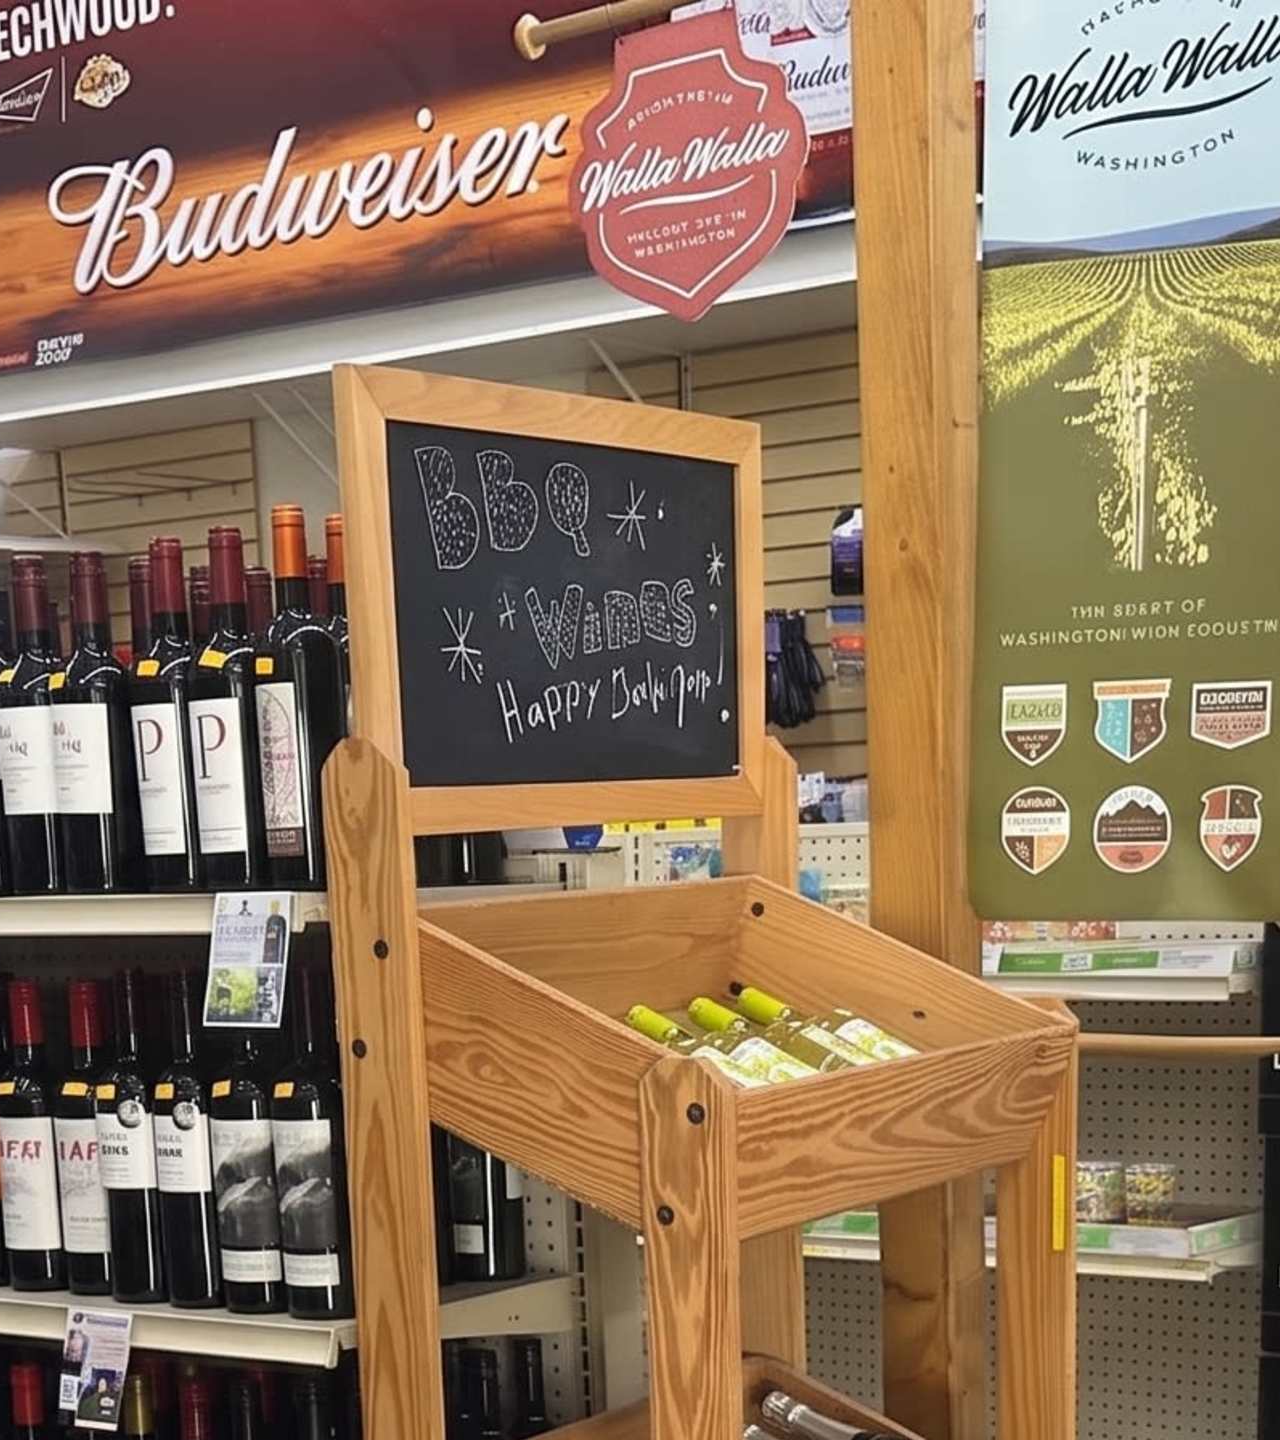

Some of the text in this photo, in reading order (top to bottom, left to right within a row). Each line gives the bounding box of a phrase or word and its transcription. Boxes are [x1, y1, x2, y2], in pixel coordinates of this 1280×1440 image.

[1008, 48, 1158, 138] Walla
[579, 121, 790, 213] Walla Walla
[1076, 128, 1235, 171] WASHINGTON
[48, 108, 570, 294] Budweiser
[414, 446, 591, 571] BBQ
[496, 676, 602, 744] Happy
